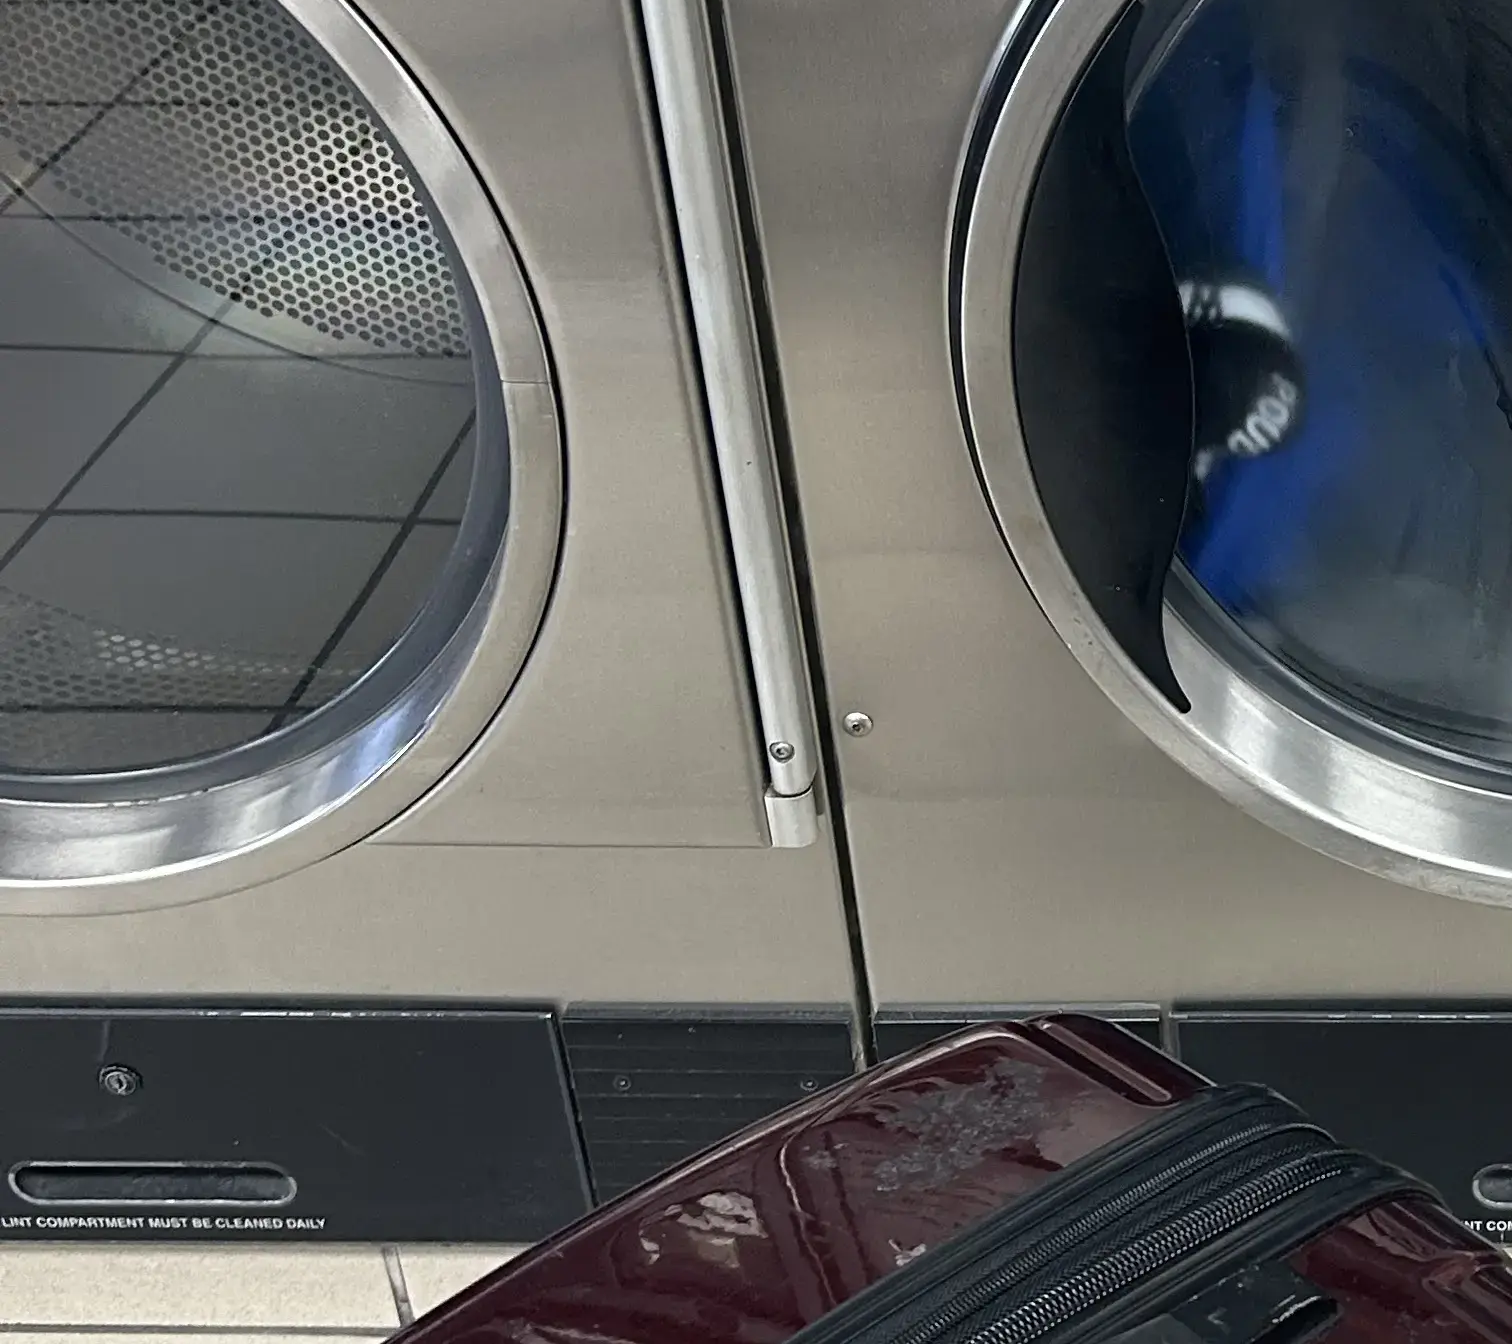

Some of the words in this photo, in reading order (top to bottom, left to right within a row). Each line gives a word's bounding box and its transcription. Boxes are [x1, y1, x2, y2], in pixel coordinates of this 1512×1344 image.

[1, 1217, 31, 1227] LINT
[36, 1217, 144, 1228] COMPARTMENT
[148, 1218, 187, 1228] MUST
[192, 1218, 212, 1228] BE
[215, 1218, 283, 1228] CLEANED
[286, 1219, 325, 1229] DAILY
